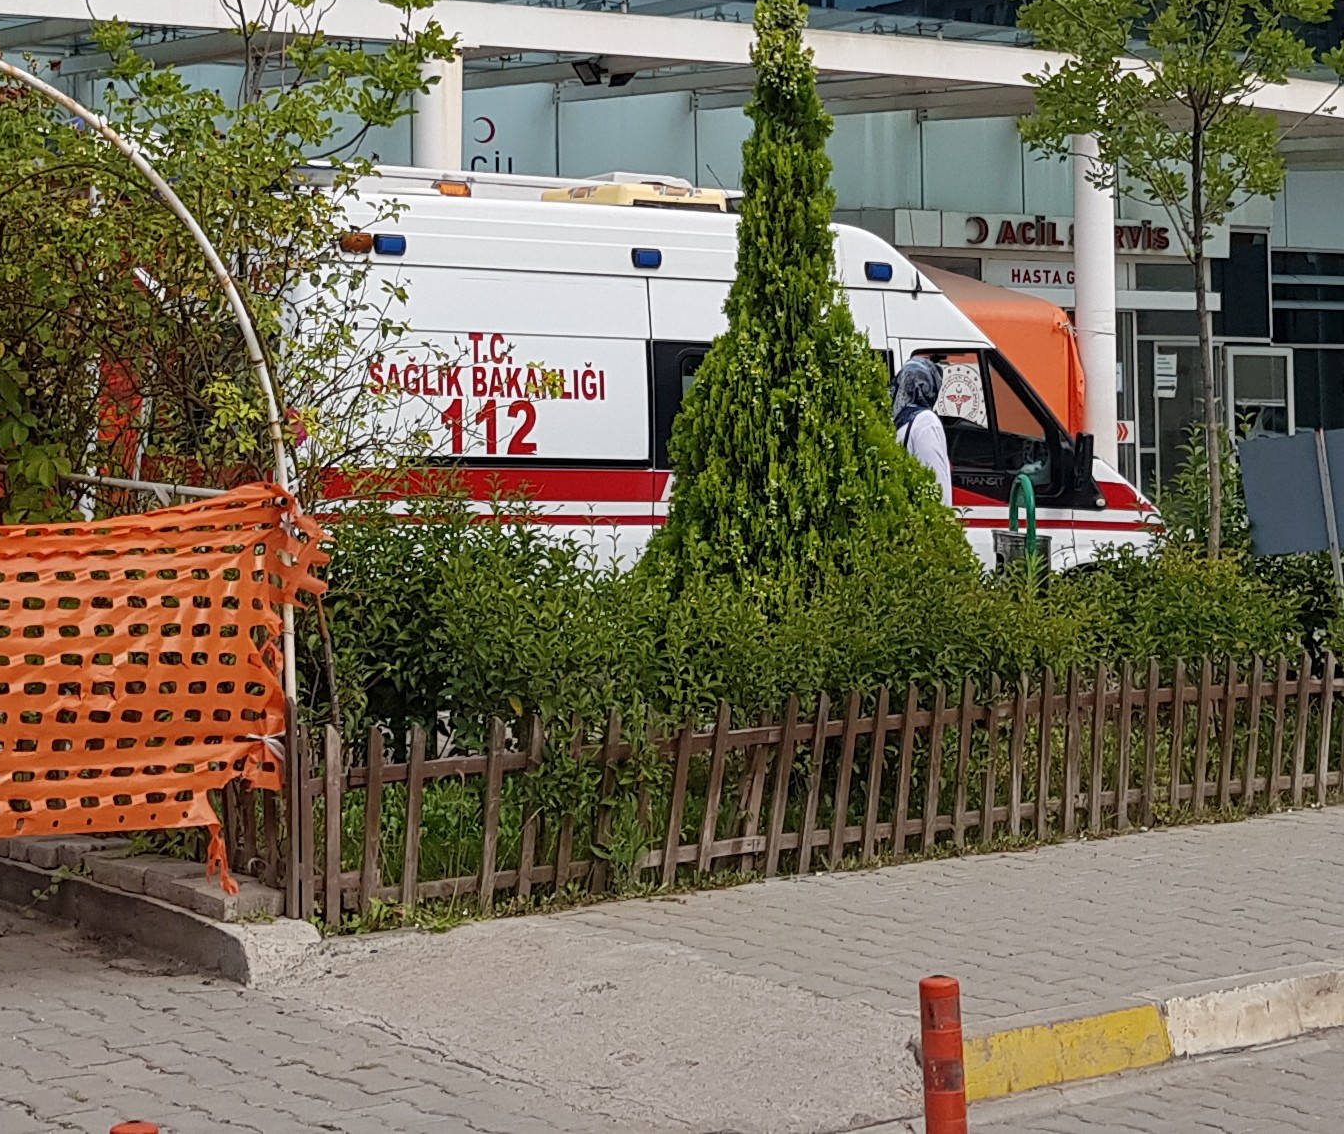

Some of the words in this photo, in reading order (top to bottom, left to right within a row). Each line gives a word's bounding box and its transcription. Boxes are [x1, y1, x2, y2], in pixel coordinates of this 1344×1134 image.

[996, 215, 1064, 247] ACİL
[1068, 220, 1170, 250] RVİS
[1012, 269, 1062, 284] HASTA
[468, 332, 513, 364] T.C.
[369, 356, 464, 397] SAĞLIK
[473, 362, 605, 400] BAKANLIĞI
[441, 399, 538, 455] 112
[961, 477, 1005, 487] TRANSIT
